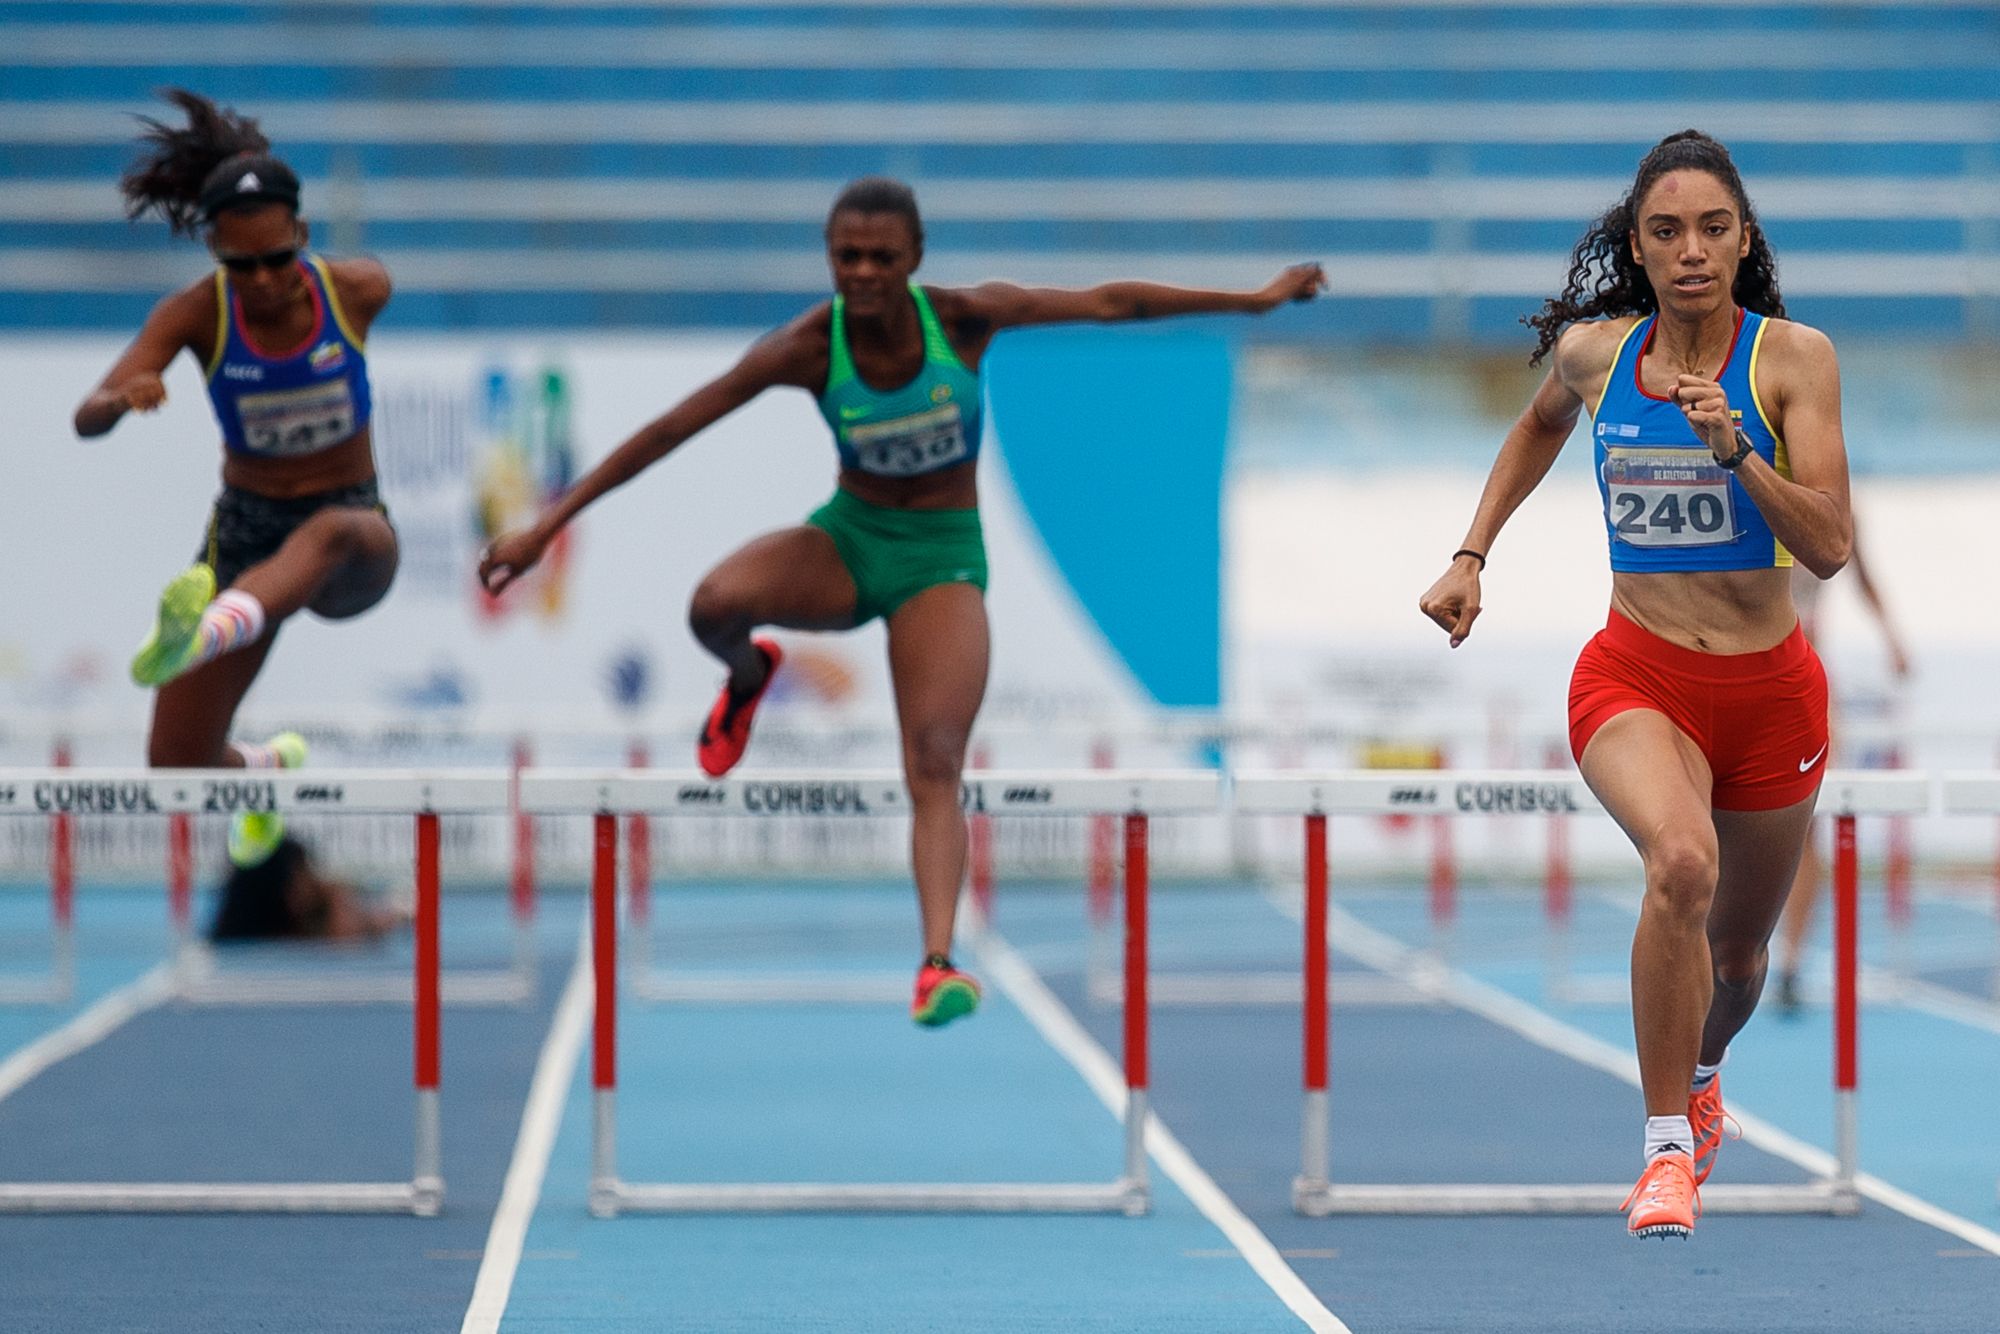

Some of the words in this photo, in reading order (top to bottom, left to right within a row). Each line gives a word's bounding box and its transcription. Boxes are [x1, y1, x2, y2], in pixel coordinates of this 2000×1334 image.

[1663, 470, 1697, 481] ATLETISMO
[1615, 492, 1725, 534] 240
[34, 780, 158, 812] CORBOL
[203, 780, 276, 812] 2001
[744, 780, 868, 812] CORBOL
[1455, 781, 1577, 811] CORBOL
